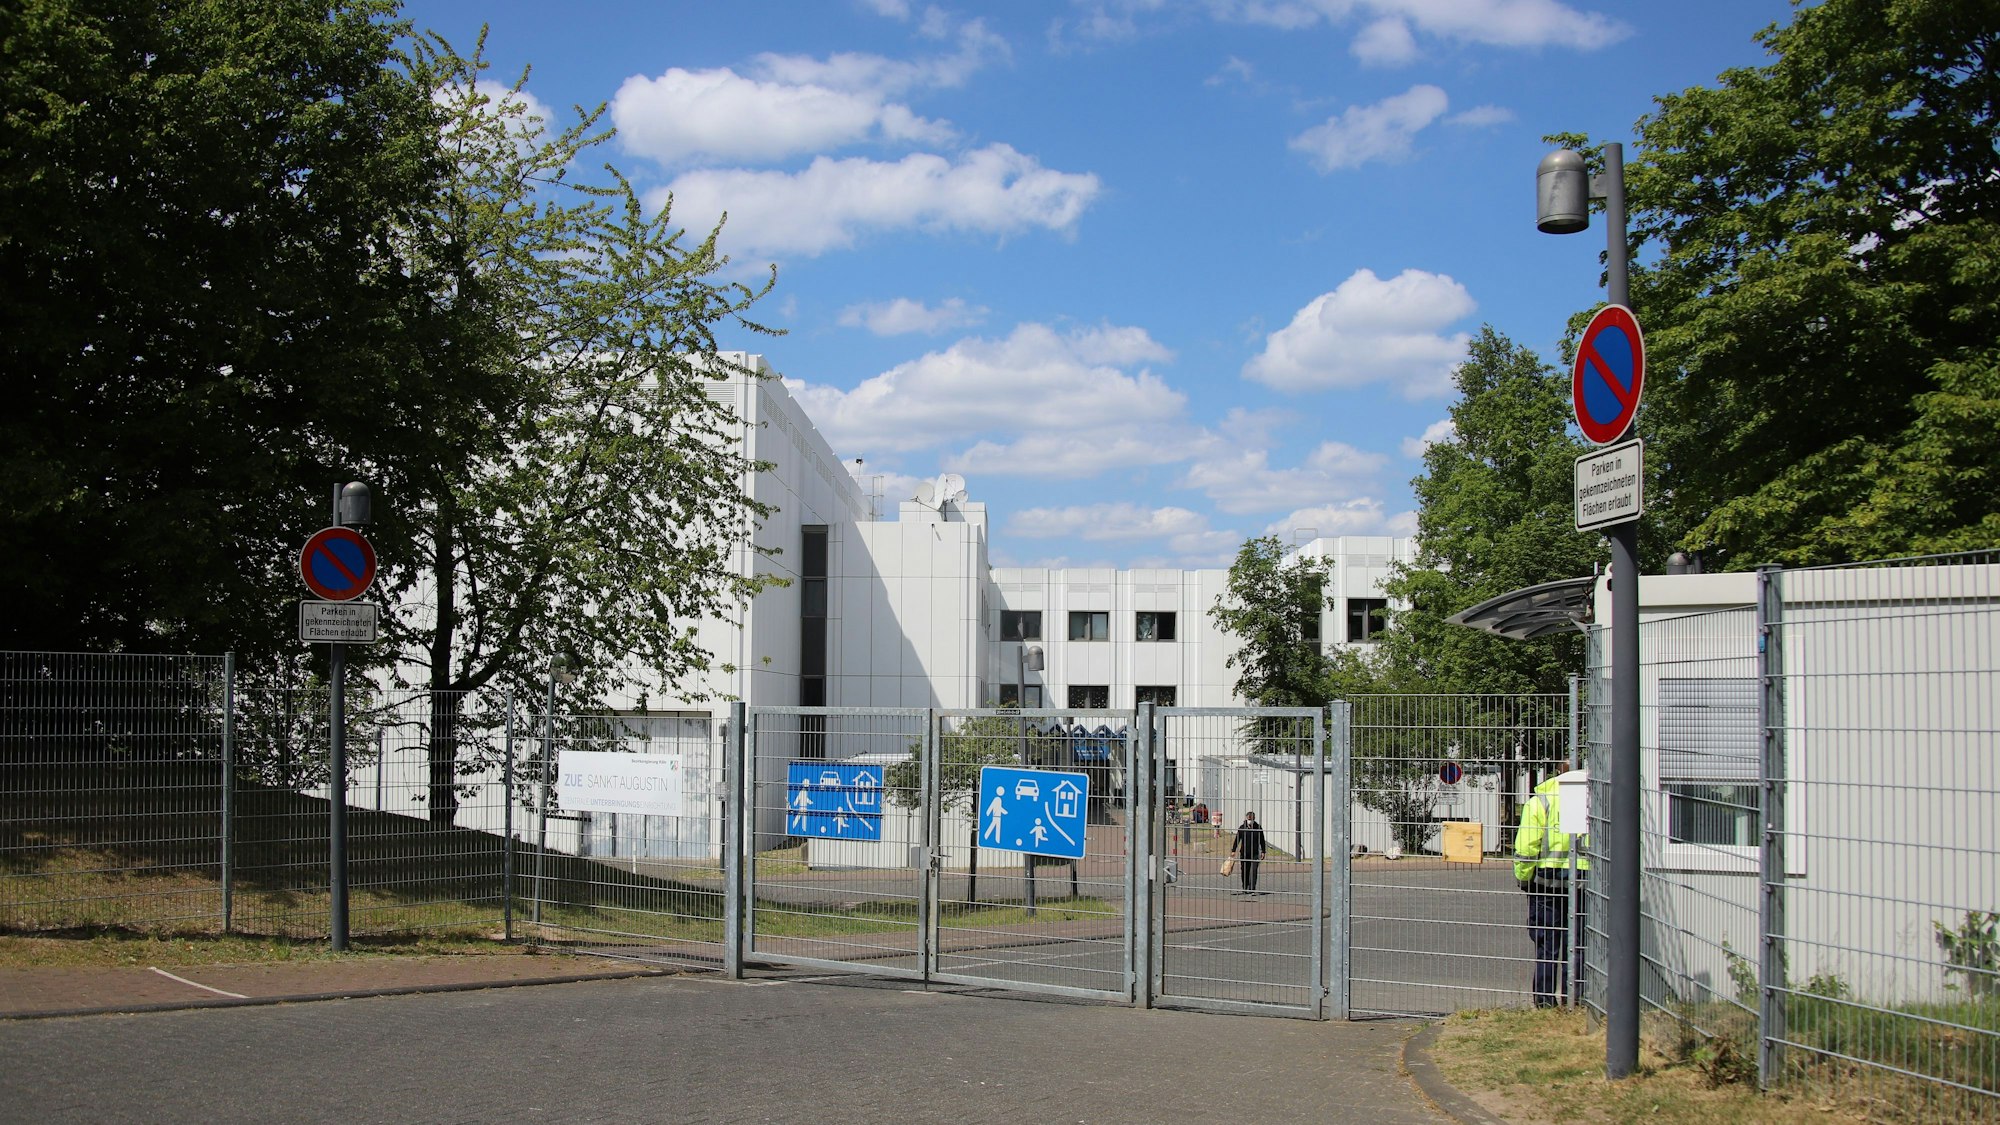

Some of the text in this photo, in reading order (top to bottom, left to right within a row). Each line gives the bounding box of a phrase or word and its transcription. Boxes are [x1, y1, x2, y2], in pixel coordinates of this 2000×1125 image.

[1591, 456, 1622, 477] Parken in
[1578, 474, 1636, 502] gekennzeichneten
[1582, 493, 1632, 517] Flächen erlaubt
[321, 607, 356, 616] Parken in
[305, 617, 372, 627] gekennzeichneten
[309, 627, 367, 637] Flächen erlaubt
[564, 773, 583, 787] ZUE
[587, 774, 619, 789] SANKT
[619, 775, 668, 791] AUGUSTIN
